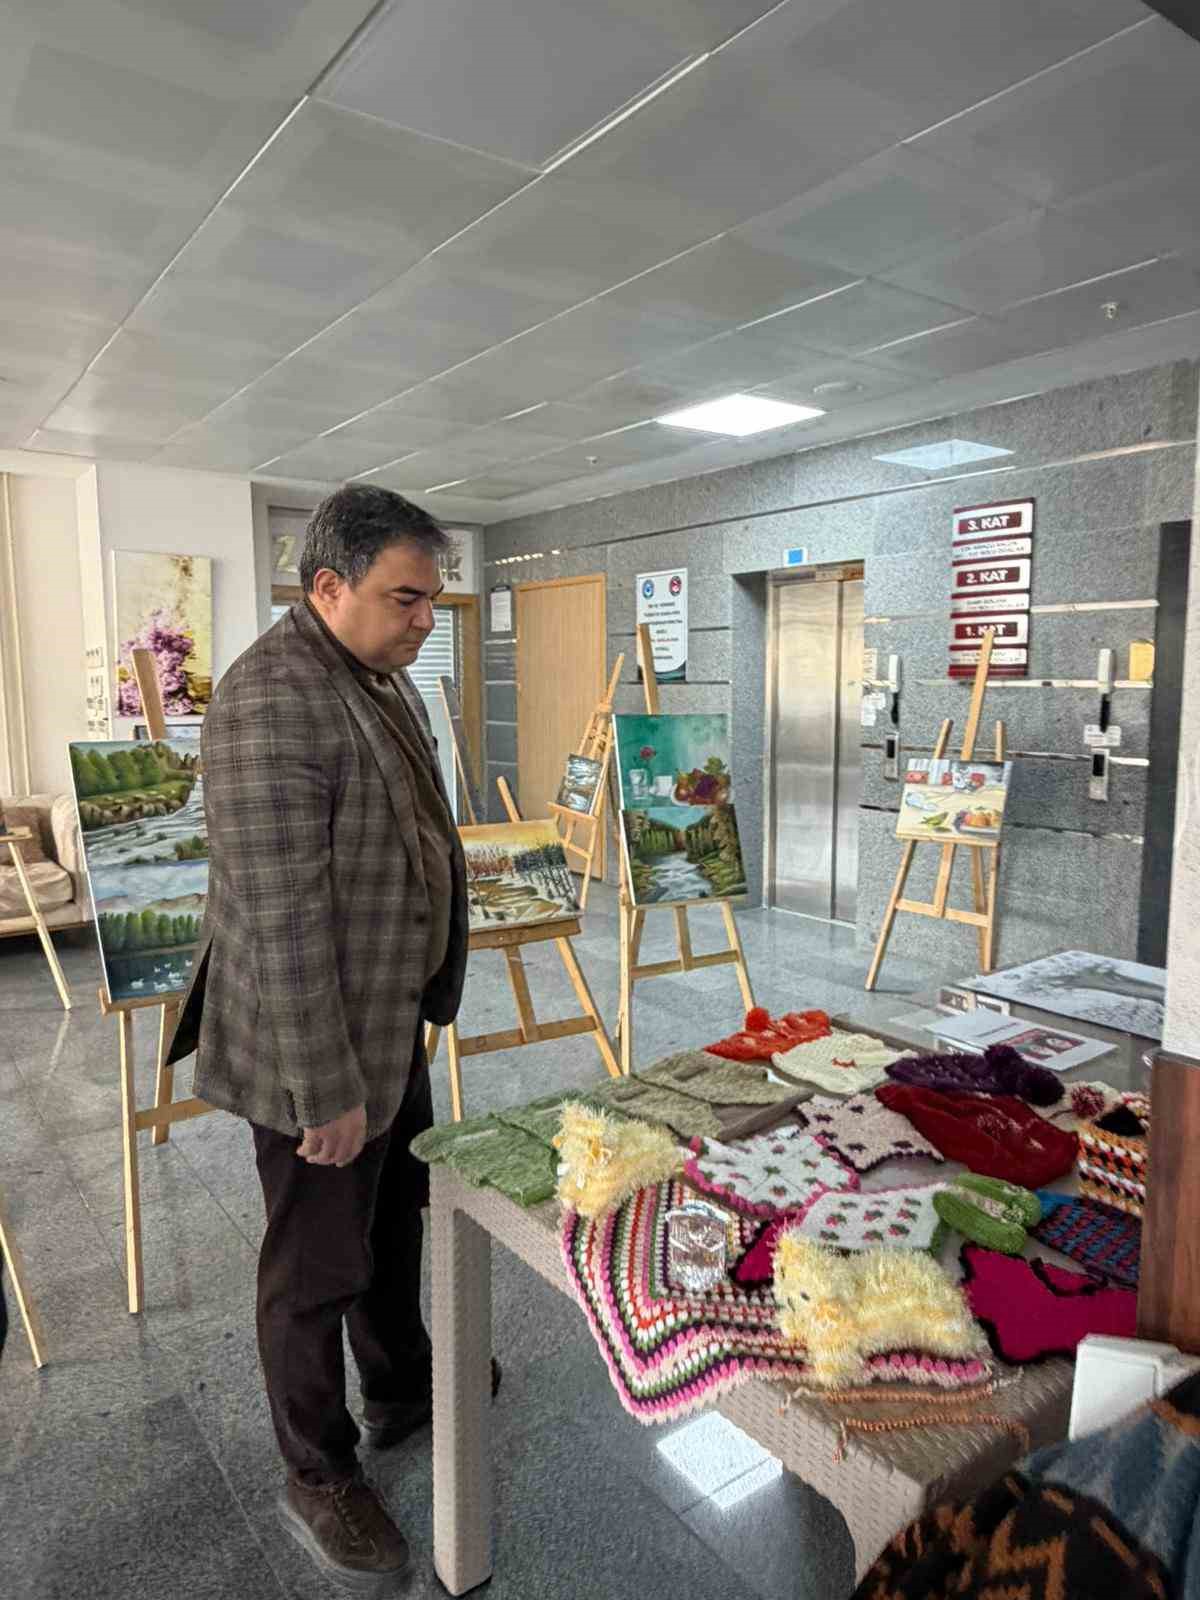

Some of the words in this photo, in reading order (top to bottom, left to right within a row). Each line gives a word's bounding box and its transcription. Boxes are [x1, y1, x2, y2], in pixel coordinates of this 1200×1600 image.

[981, 515, 1010, 529] KAT
[966, 573, 978, 584] 2.
[979, 569, 1008, 582] KAT
[965, 626, 976, 636] 1.
